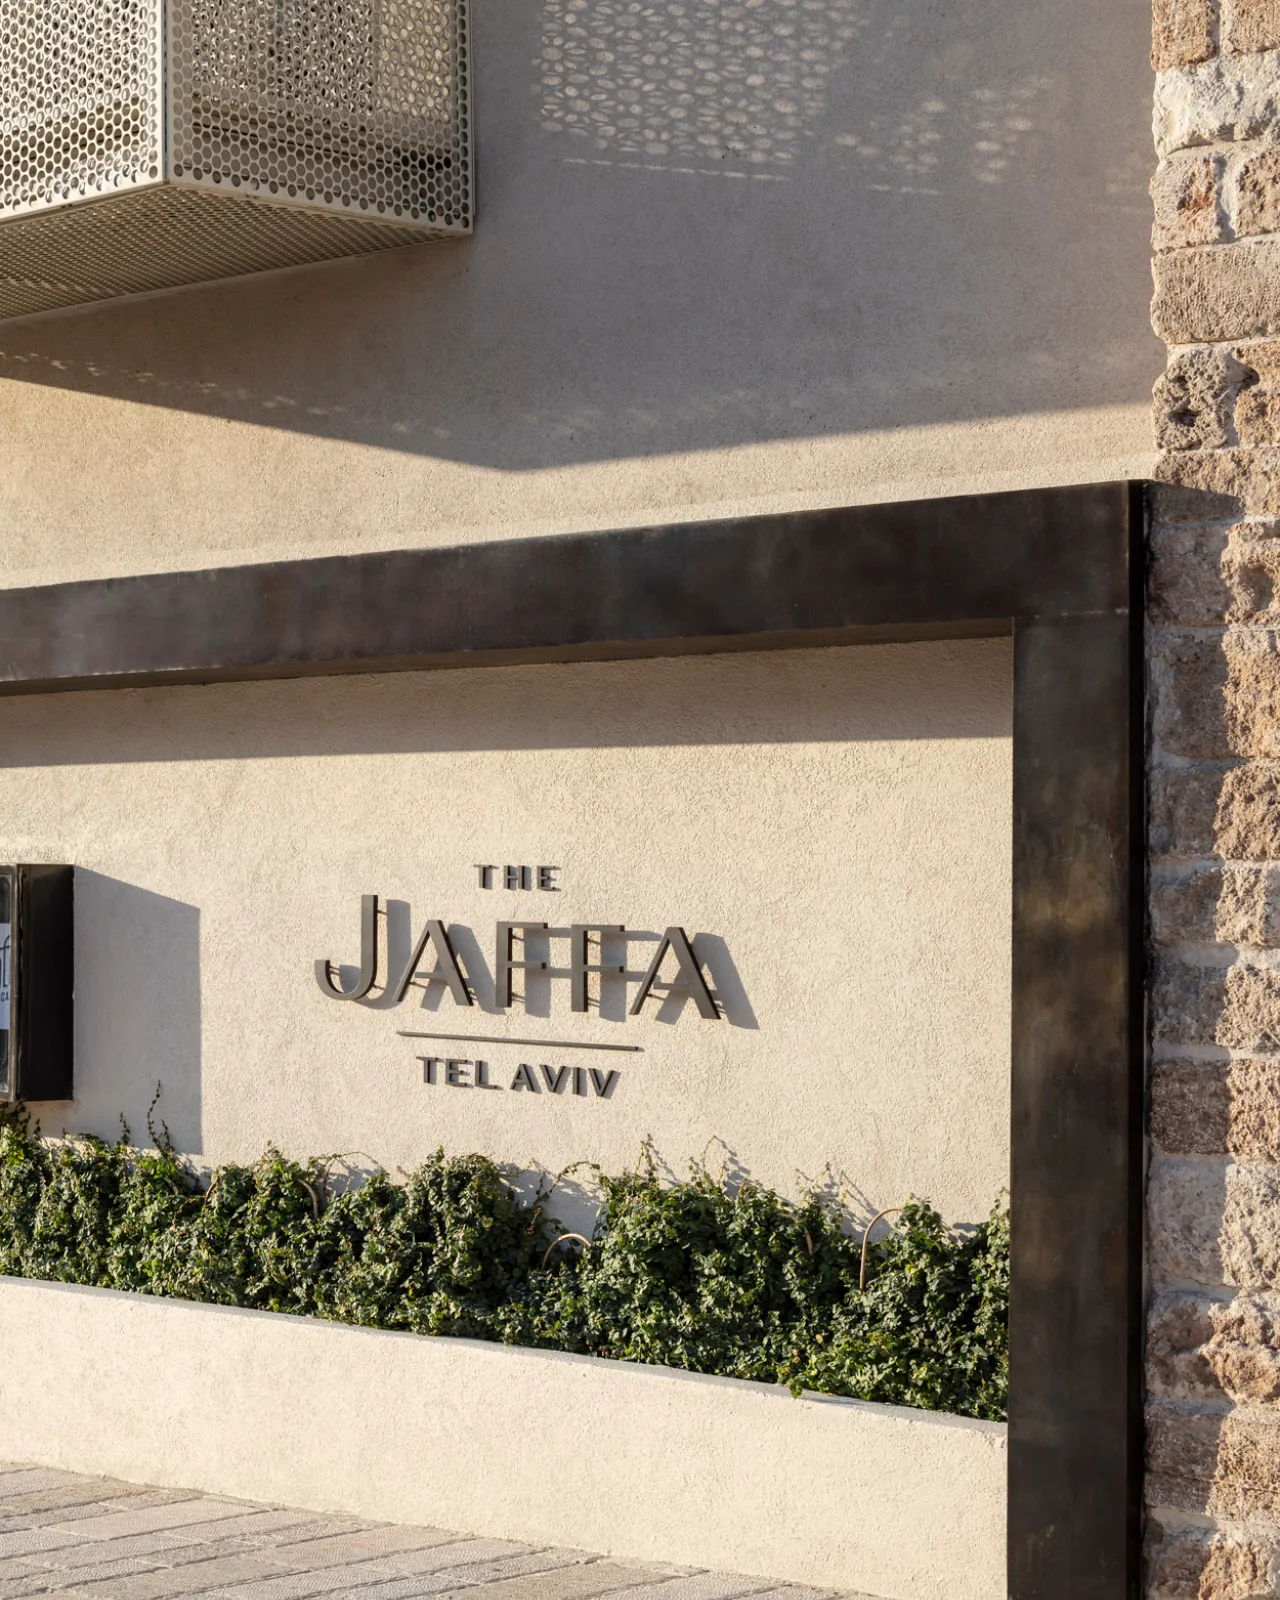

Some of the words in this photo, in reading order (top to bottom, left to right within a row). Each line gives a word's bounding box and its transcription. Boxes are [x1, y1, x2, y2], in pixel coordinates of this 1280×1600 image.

[473, 864, 558, 891] THE
[314, 894, 722, 1020] JAFFA
[416, 1056, 500, 1090] TEL
[509, 1063, 620, 1098] AVIV
